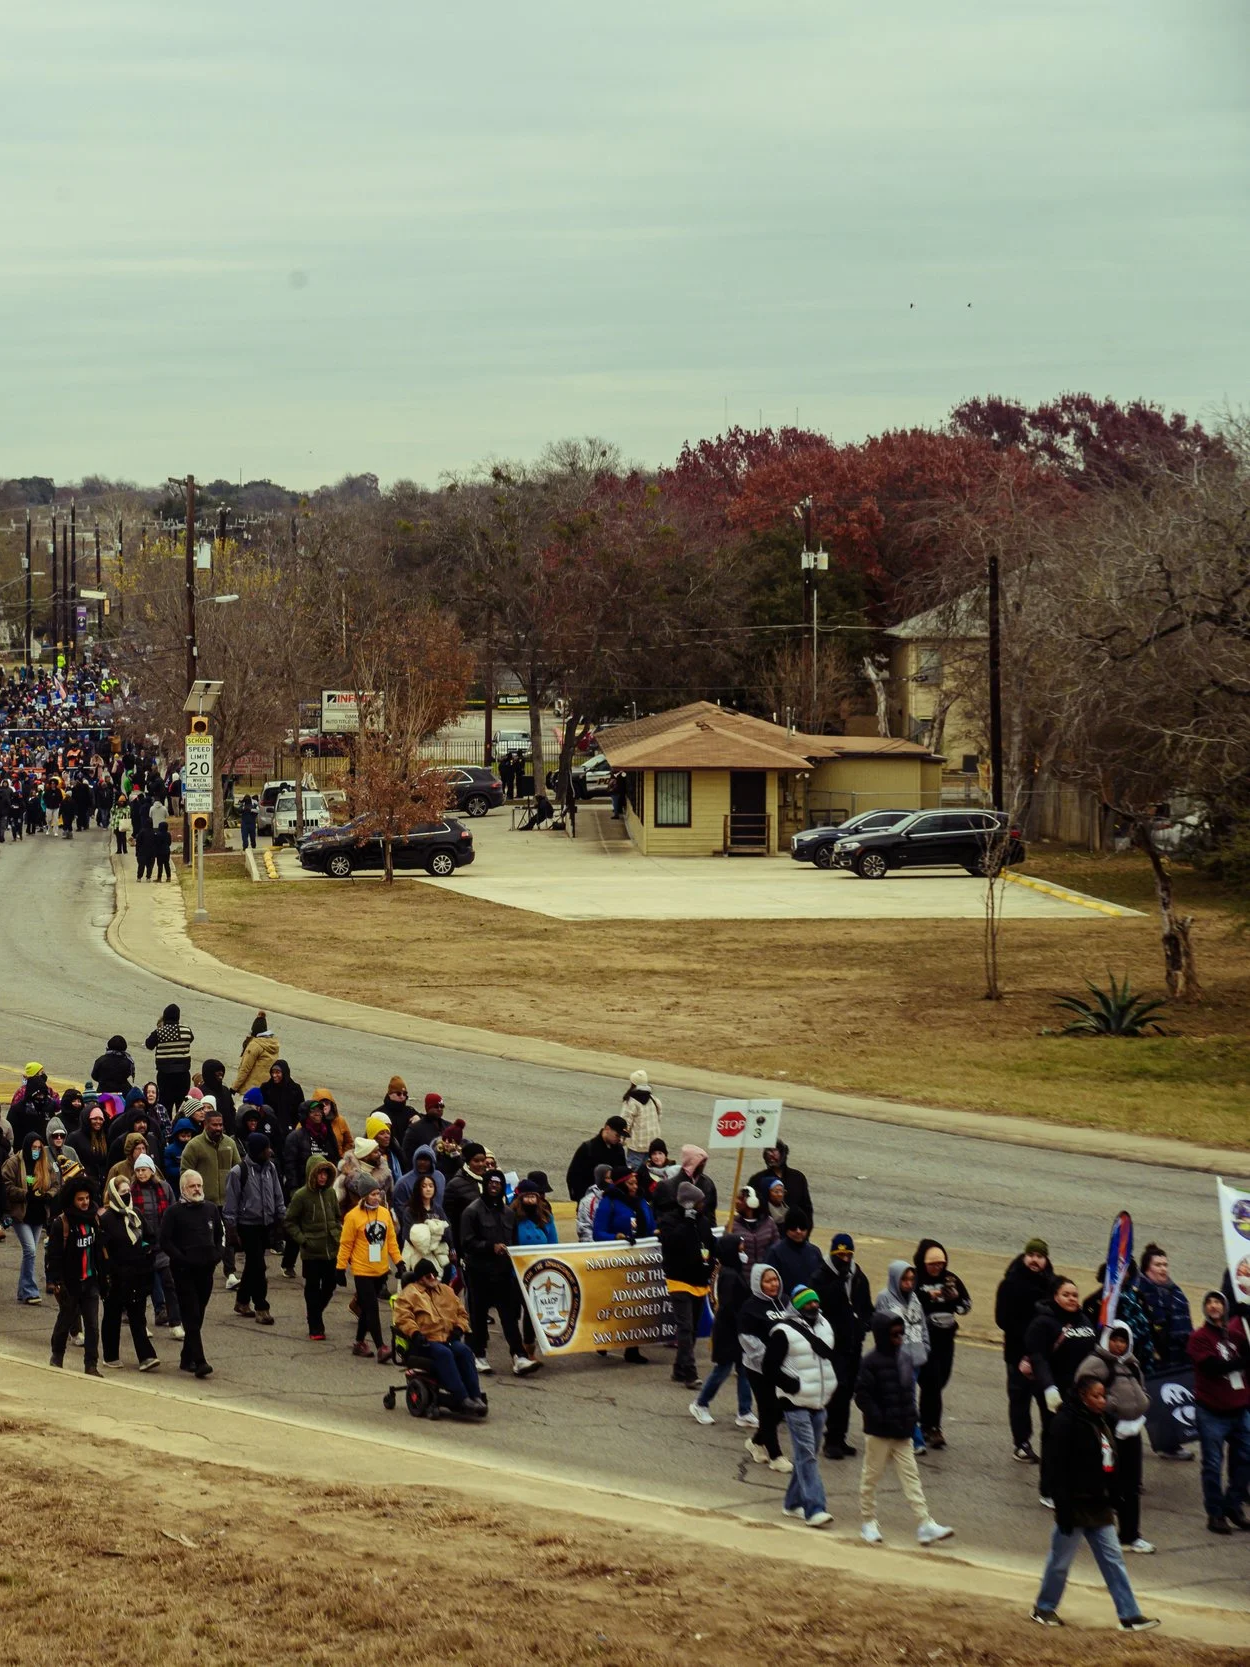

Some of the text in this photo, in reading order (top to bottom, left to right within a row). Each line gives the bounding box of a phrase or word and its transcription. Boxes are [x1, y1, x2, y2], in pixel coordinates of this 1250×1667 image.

[189, 762, 210, 775] 20
[716, 1119, 746, 1130] STOP
[753, 1127, 762, 1139] 3
[585, 1256, 638, 1271] NATIONAL
[626, 1268, 667, 1283] FOR THE
[596, 1308, 611, 1321] OF
[613, 1303, 661, 1319] COLORED
[592, 1331, 613, 1345] SAN
[614, 1326, 660, 1342] ANTONIO
